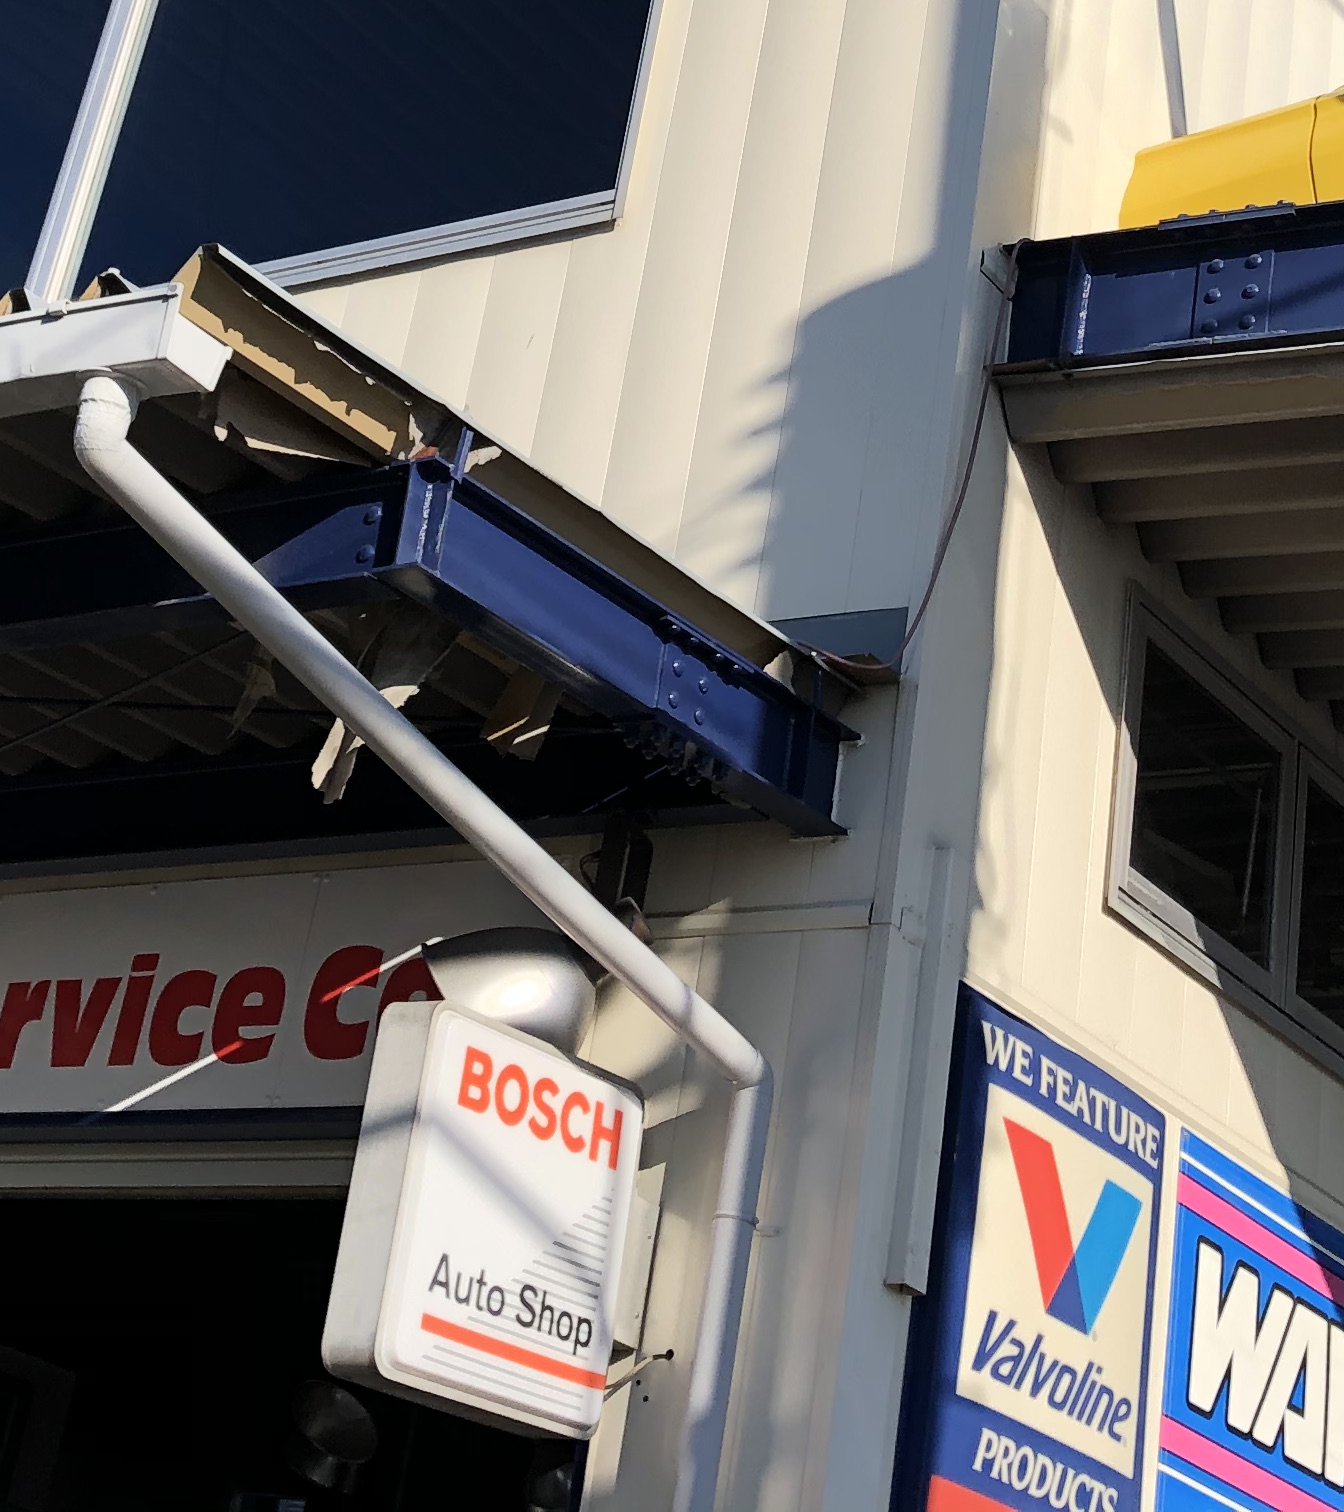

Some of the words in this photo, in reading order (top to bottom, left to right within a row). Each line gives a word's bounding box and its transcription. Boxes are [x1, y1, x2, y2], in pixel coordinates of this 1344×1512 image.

[457, 1045, 624, 1171] BOSCH
[981, 1020, 1034, 1087] WE
[1038, 1054, 1161, 1170] FEATURE
[428, 1252, 505, 1317] Auto
[515, 1284, 593, 1355] Shop
[971, 1309, 1133, 1443] Valvoline
[971, 1427, 1119, 1512] PRODUCTS
